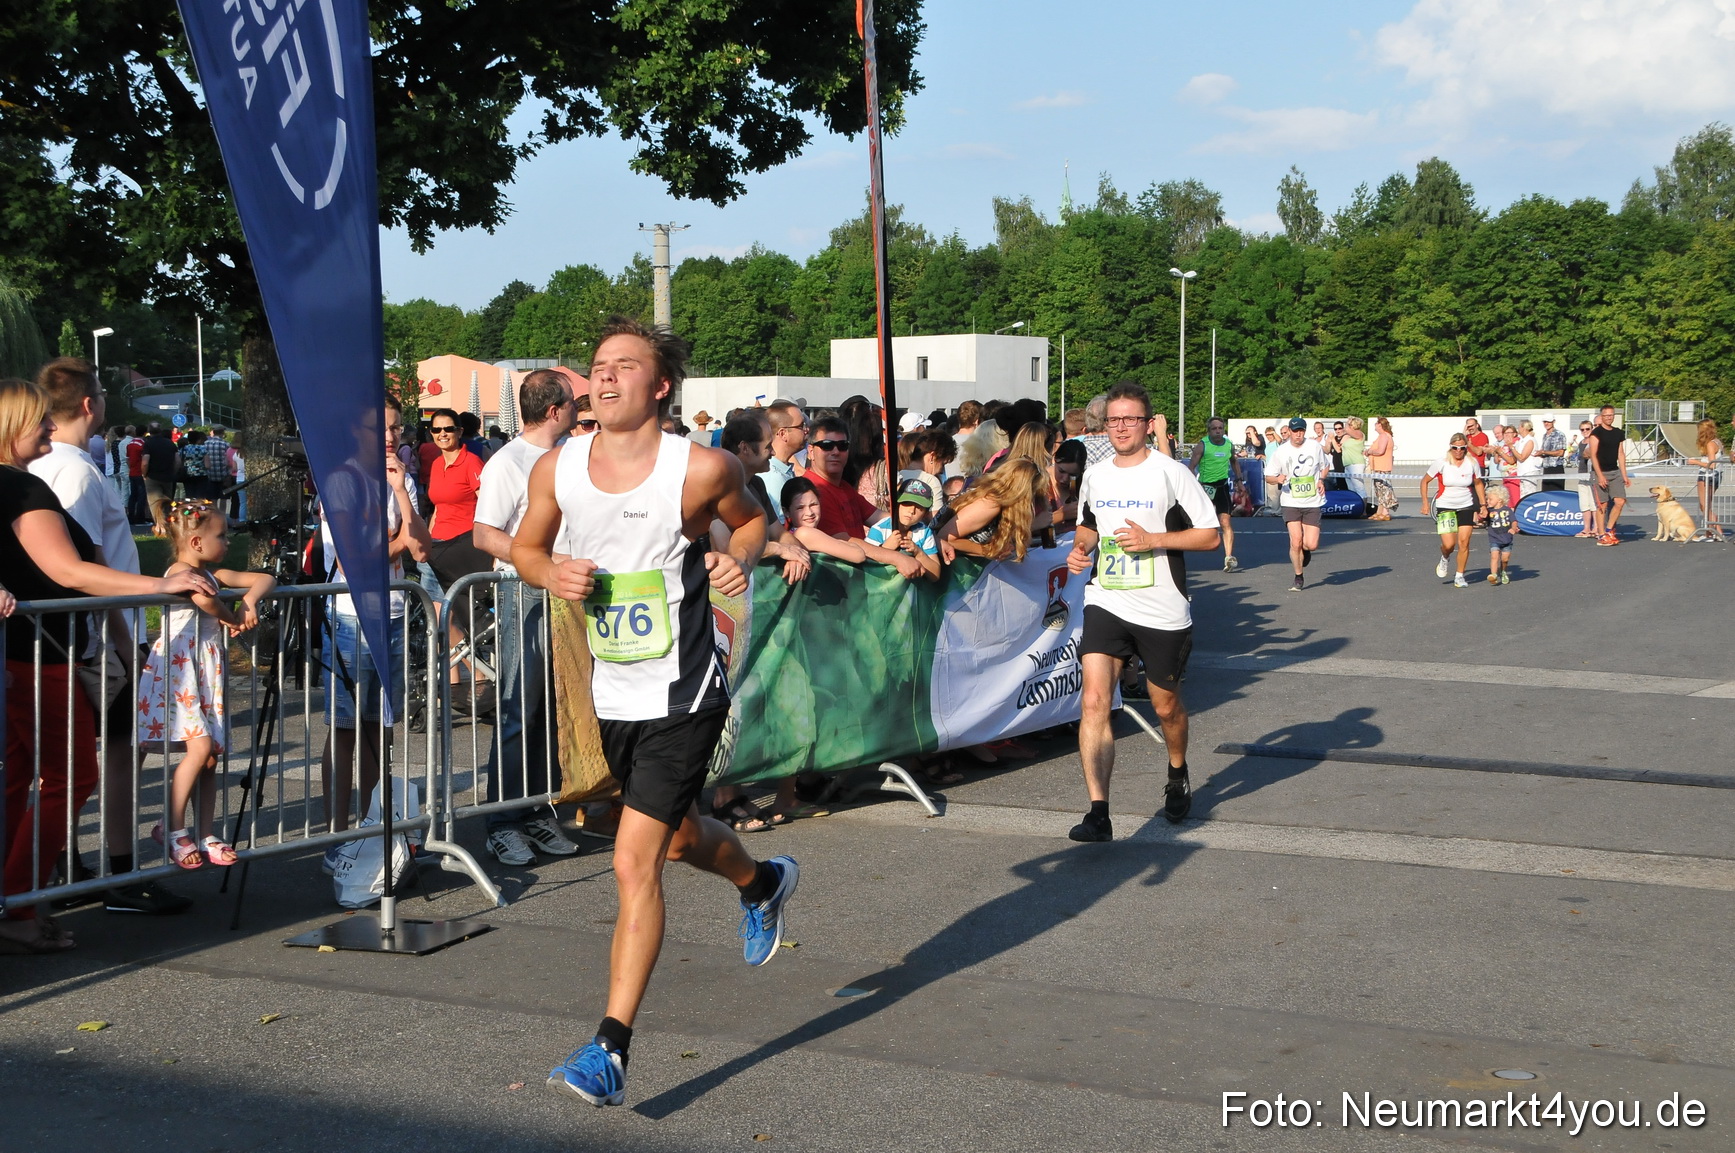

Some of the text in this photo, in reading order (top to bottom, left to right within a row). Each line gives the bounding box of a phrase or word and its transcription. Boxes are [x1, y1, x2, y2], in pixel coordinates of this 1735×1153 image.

[1294, 484, 1312, 493] 300
[1096, 500, 1153, 509] DELPHI
[623, 510, 649, 519] Daniel
[1105, 555, 1140, 575] 211
[593, 602, 653, 639] 876
